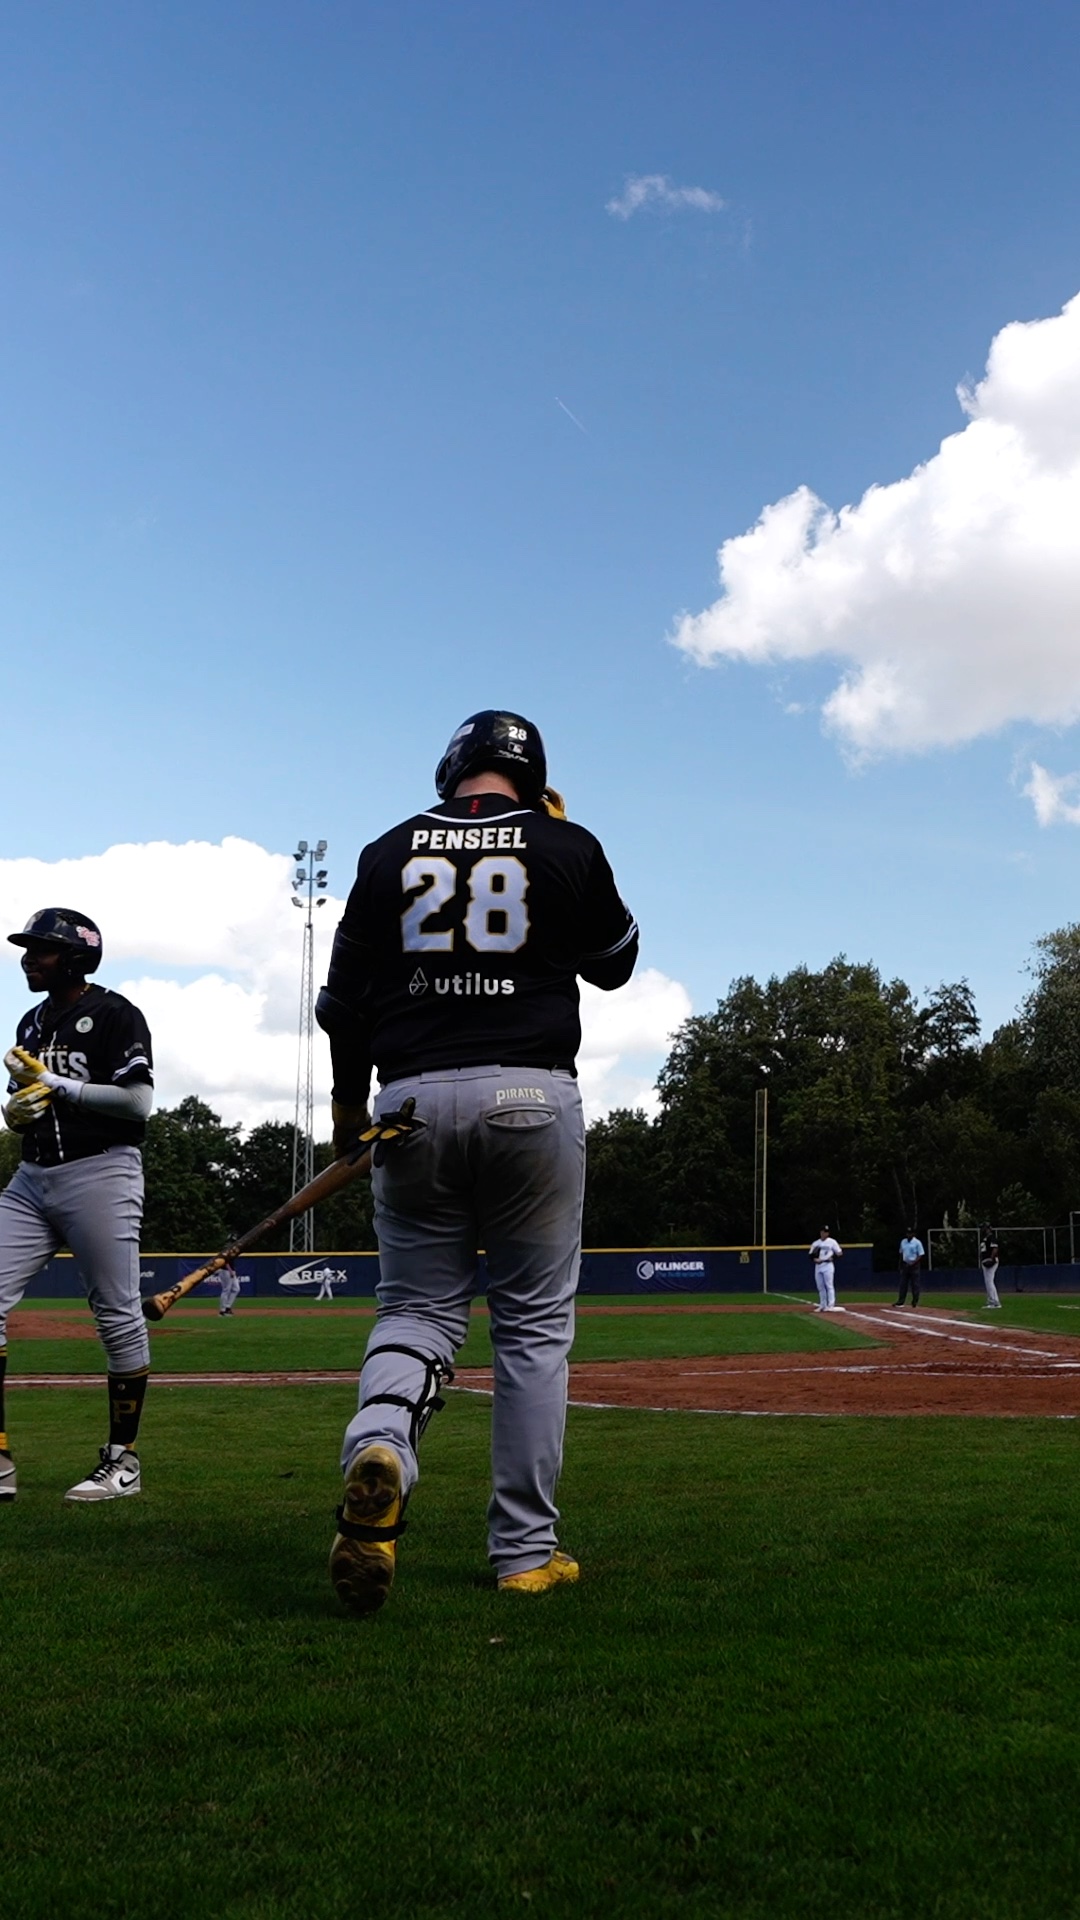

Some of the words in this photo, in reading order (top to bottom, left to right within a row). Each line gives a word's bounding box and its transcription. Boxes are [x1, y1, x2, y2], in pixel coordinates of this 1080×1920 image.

[508, 726, 527, 741] 28
[411, 827, 527, 850] PENSEEL
[401, 856, 531, 953] 28
[434, 972, 515, 995] utilus
[496, 1088, 546, 1105] PIRATES
[654, 1261, 705, 1271] KLINGER
